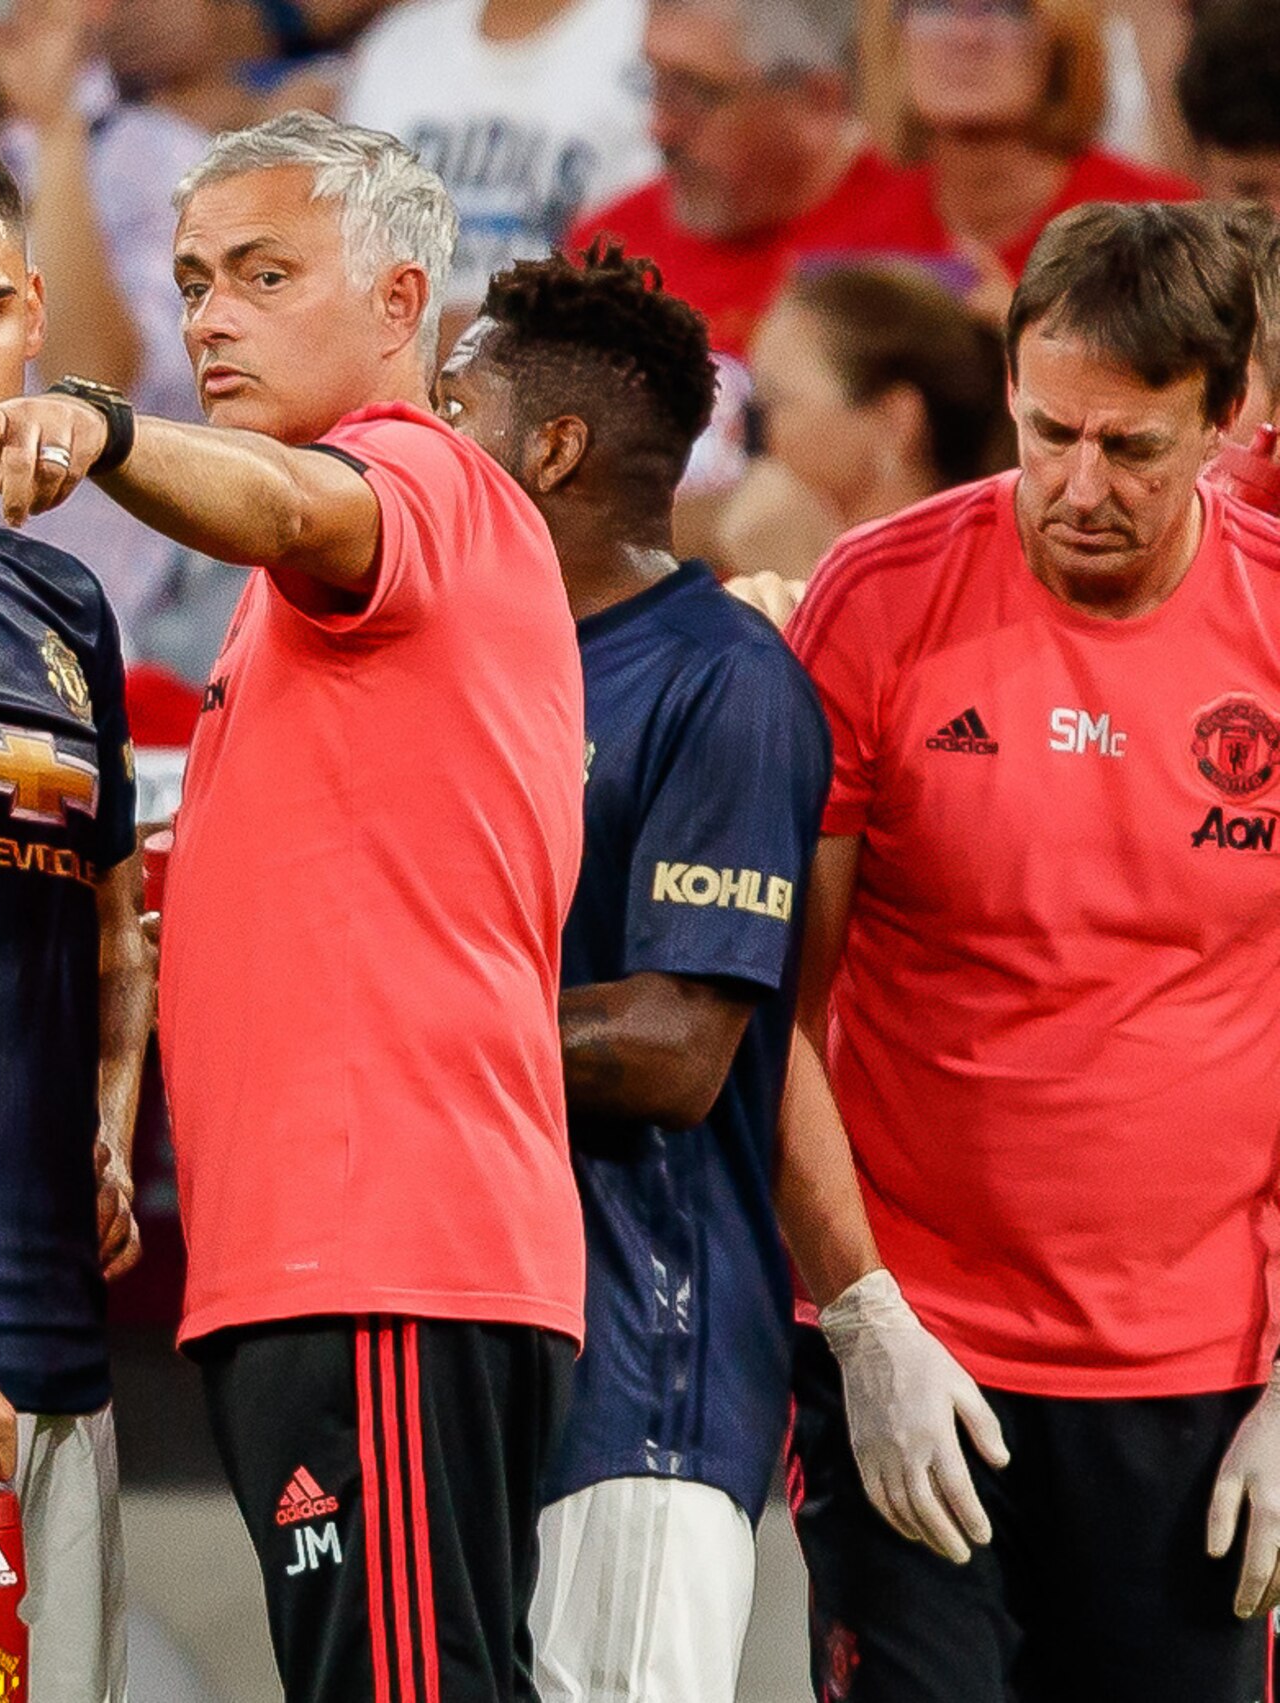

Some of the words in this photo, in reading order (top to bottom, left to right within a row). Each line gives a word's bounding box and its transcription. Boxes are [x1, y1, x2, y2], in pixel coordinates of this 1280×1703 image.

[201, 674, 230, 713] ON
[925, 738, 999, 755] adidas
[276, 1496, 339, 1526] adidas
[286, 1522, 342, 1576] JM
